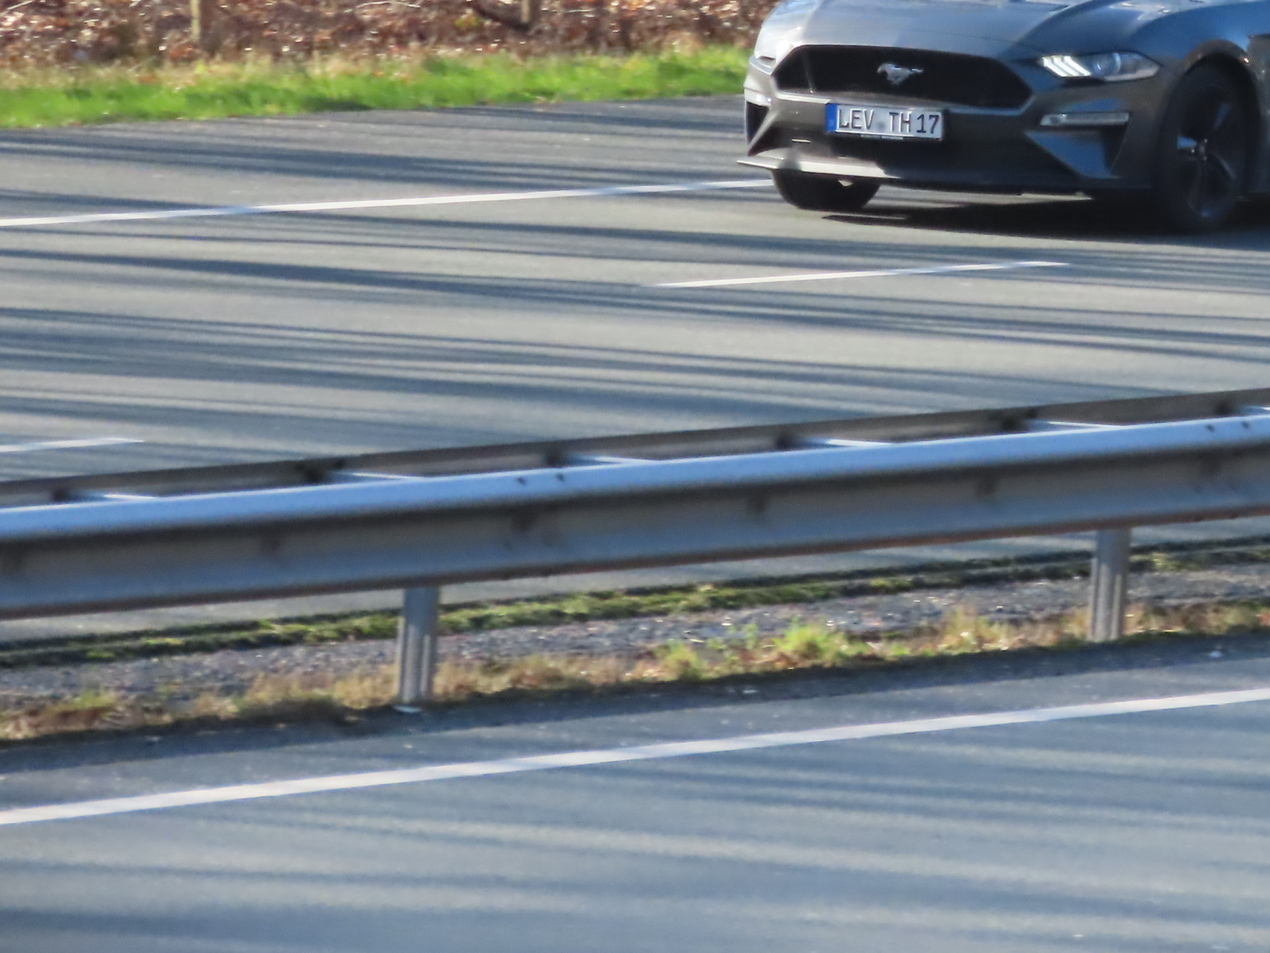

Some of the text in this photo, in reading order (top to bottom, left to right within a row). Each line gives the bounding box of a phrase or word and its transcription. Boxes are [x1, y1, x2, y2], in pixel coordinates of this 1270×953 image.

[837, 108, 940, 134] LEV TH 17
